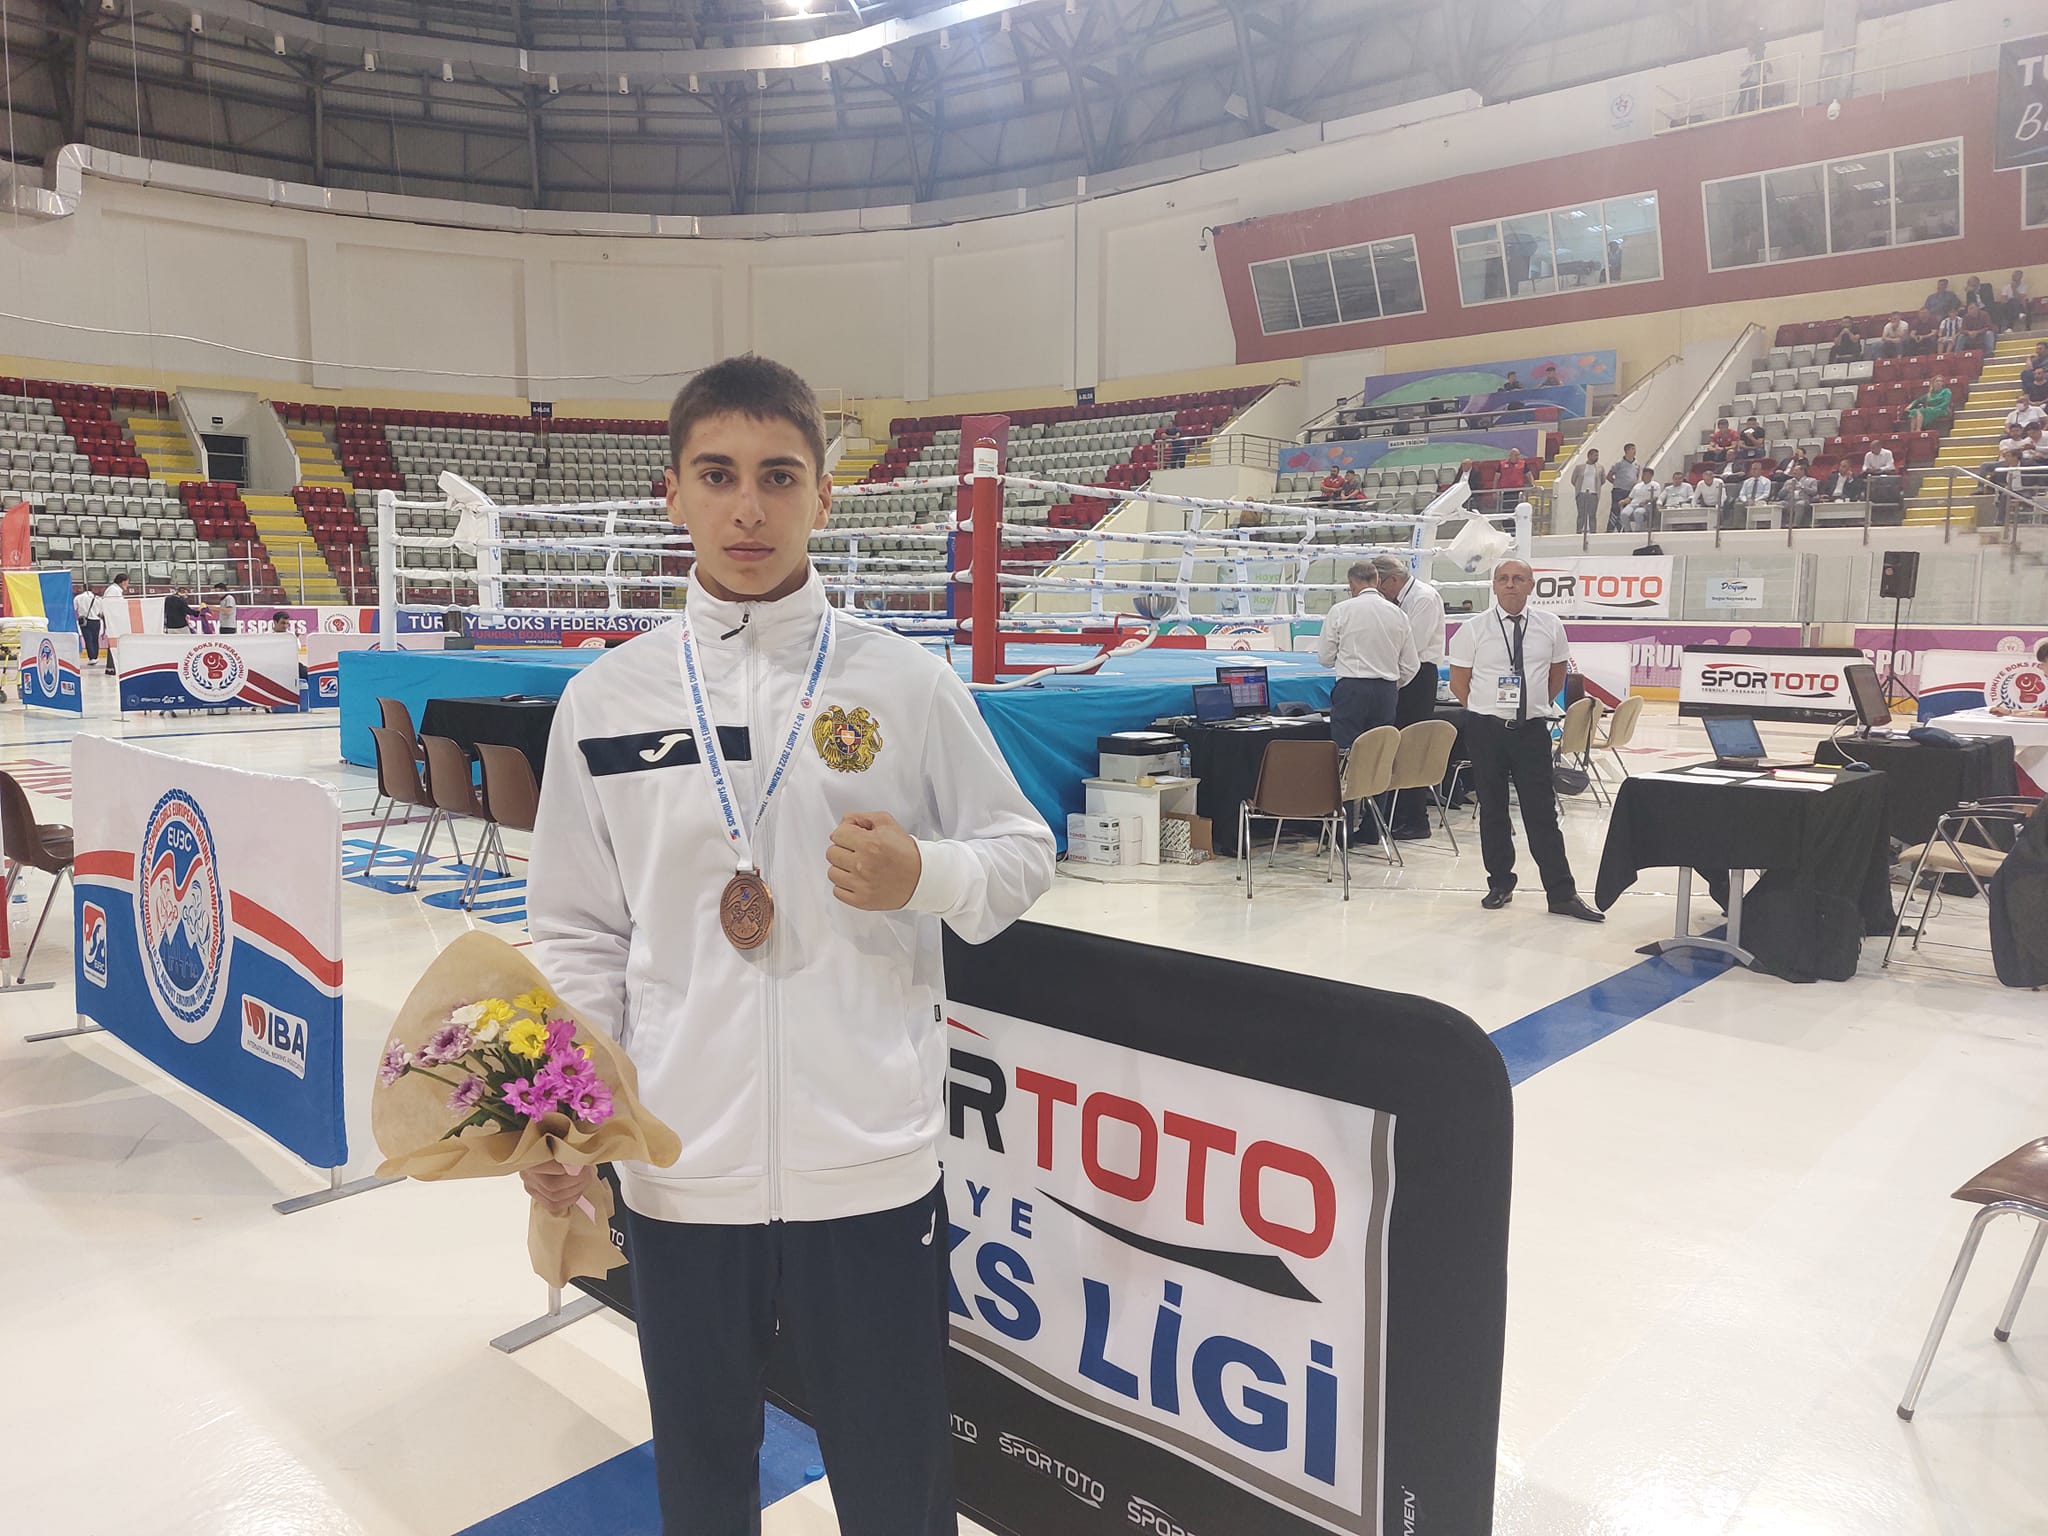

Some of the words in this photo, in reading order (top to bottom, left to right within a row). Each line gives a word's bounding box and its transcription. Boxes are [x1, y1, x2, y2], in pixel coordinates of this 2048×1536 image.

[1536, 575, 1664, 599] ORTOTO
[247, 619, 307, 635] SPOTS
[408, 613, 490, 630] TÜRYE
[495, 616, 545, 631] BOKS
[550, 615, 666, 632] FEDERASYON
[804, 652, 826, 698] CHAMPIONSHIPS
[1700, 669, 1840, 692] SPORTOTO
[690, 682, 703, 705] BOXING
[695, 704, 711, 737] EUROPEAN
[793, 712, 806, 731] 10-21
[703, 735, 722, 778] SCHOOLGIRLS
[778, 749, 791, 768] 2022
[766, 766, 784, 797] ERZURUM
[717, 785, 737, 827] SCHOOLBOYS
[205, 866, 219, 974] CHAMPIONSHIPS
[267, 1011, 305, 1062] IBA
[944, 1047, 1337, 1260] RTOTO
[610, 1227, 625, 1247] TO
[1077, 1276, 1338, 1487] LİGİ
[950, 1413, 978, 1439] TO
[998, 1435, 1105, 1502] SPORTOTO
[1403, 1490, 1415, 1536] MEN
